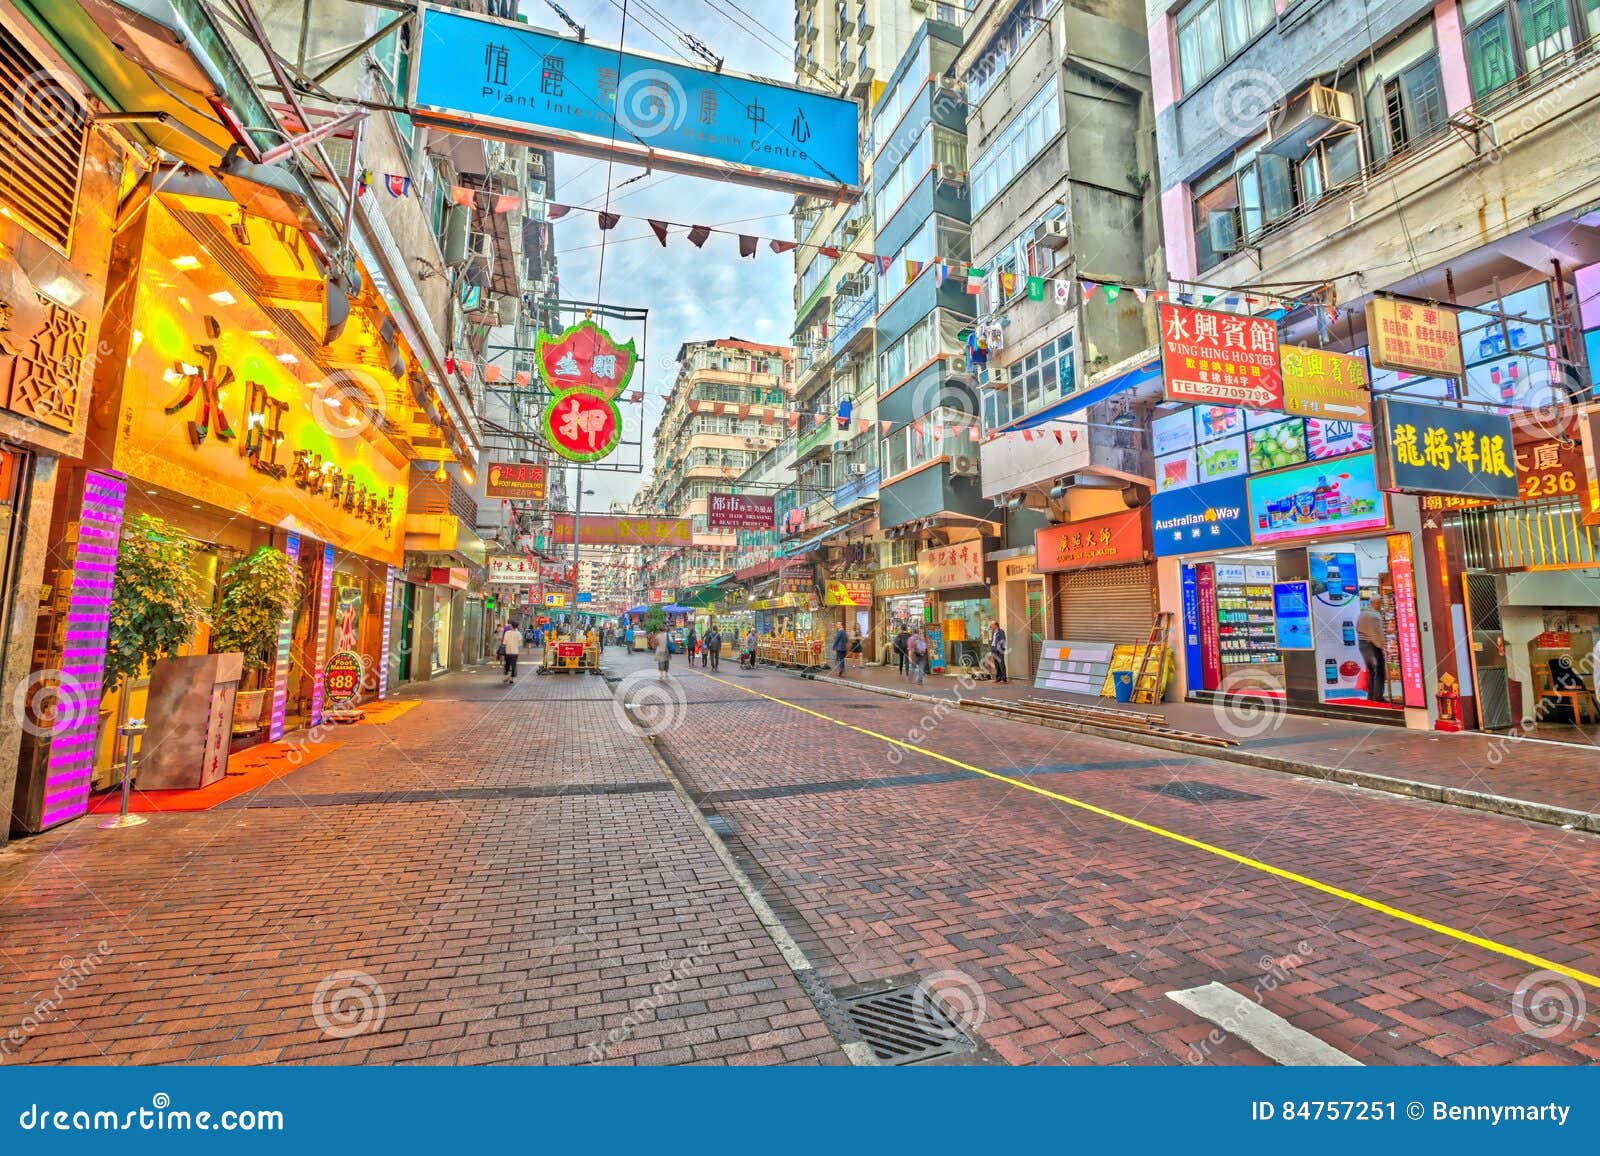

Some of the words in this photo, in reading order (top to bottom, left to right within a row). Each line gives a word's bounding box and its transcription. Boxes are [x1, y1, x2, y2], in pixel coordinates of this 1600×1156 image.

[481, 86, 536, 108] Plant
[546, 99, 673, 135] International
[682, 126, 741, 147] Health
[751, 140, 809, 161] Centre
[1167, 308, 1275, 352] 永興賓館
[1168, 341, 1197, 356] WING
[1200, 347, 1228, 361] HING
[1232, 351, 1275, 366] HOSTEL
[1174, 381, 1270, 401] TEL:27709798
[559, 399, 607, 448] 押
[1393, 424, 1514, 478] 龍將洋服
[712, 496, 740, 511] 都市
[1155, 514, 1205, 531] Australian
[1216, 507, 1240, 520] Way
[330, 675, 353, 688] $88
